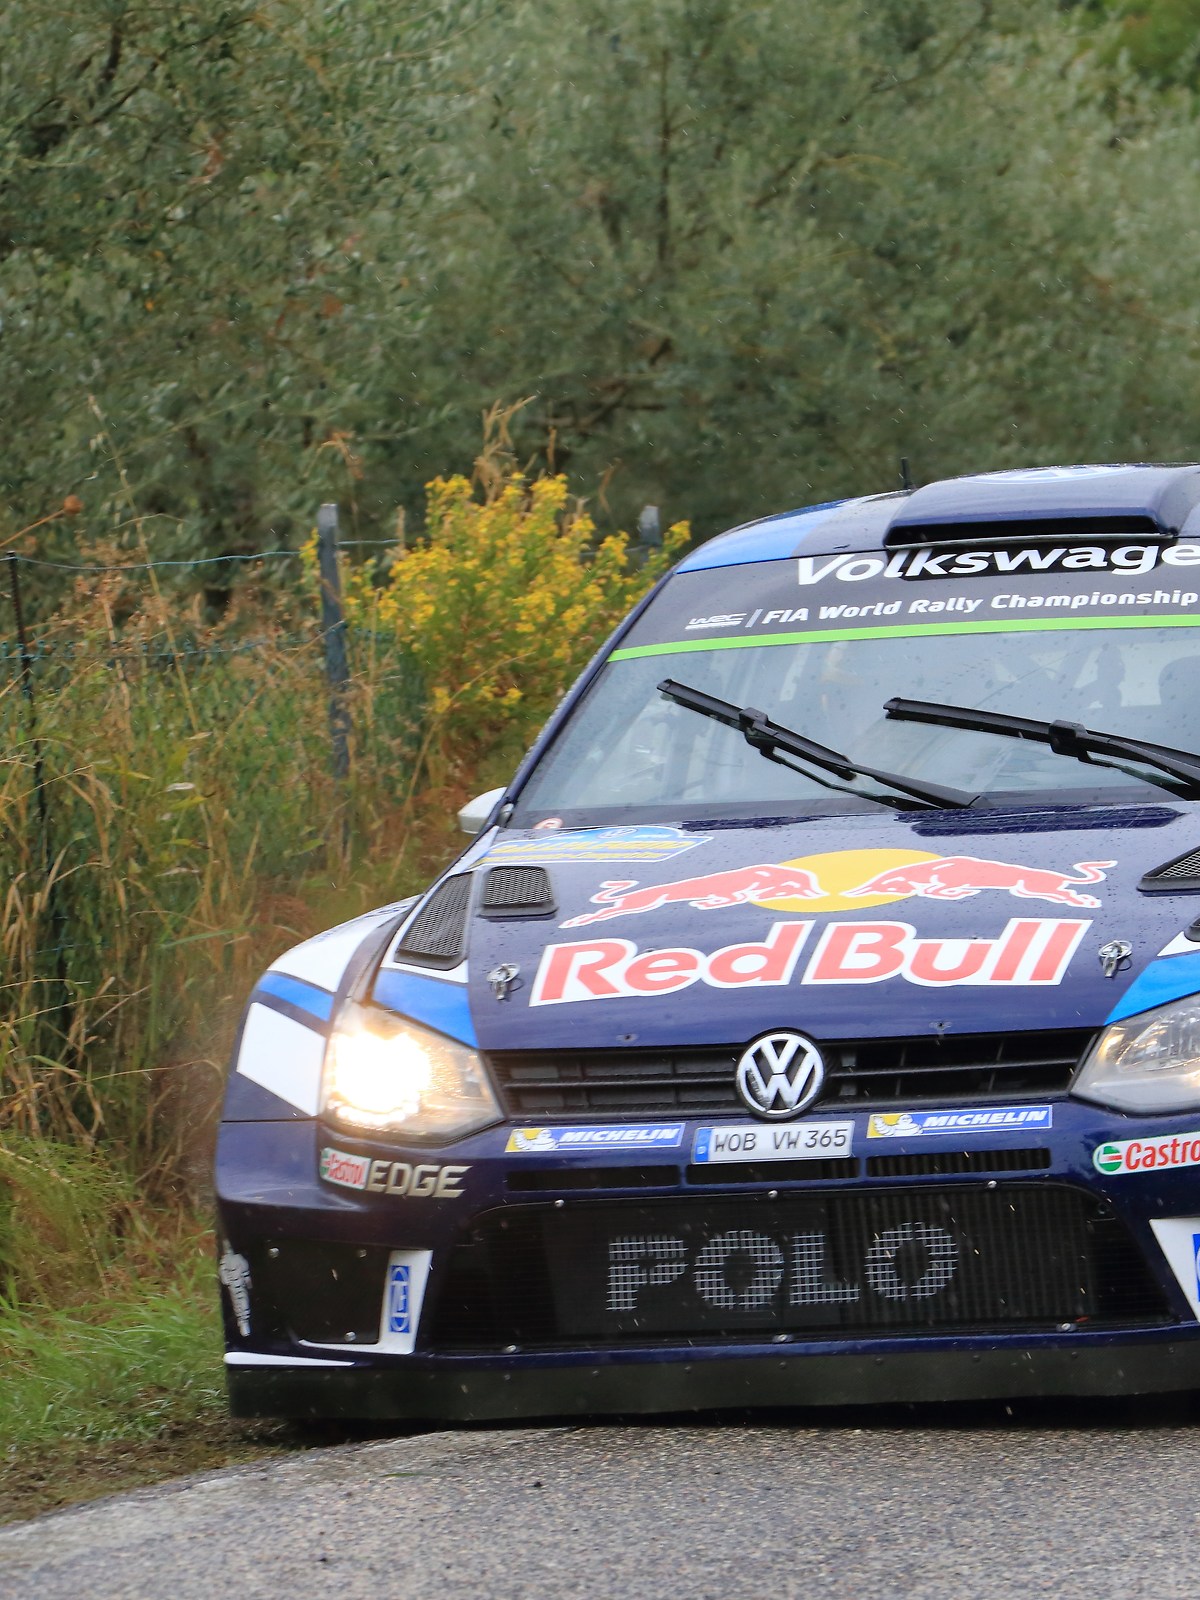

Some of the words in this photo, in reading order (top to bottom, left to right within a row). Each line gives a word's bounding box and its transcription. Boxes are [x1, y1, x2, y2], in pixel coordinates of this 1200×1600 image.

[761, 608, 809, 624] FIA
[819, 601, 902, 619] World
[908, 596, 983, 613] Rally
[990, 589, 1199, 609] Championship
[531, 920, 814, 1005] Red
[803, 919, 1092, 986] Bull
[558, 1128, 680, 1142] MICHELIN
[922, 1110, 1048, 1127] MICHELIN
[714, 1132, 757, 1153] WOB
[773, 1130, 802, 1150] VW
[805, 1128, 848, 1148] 365
[366, 1159, 473, 1198] EDGE
[605, 1221, 960, 1311] POLO
